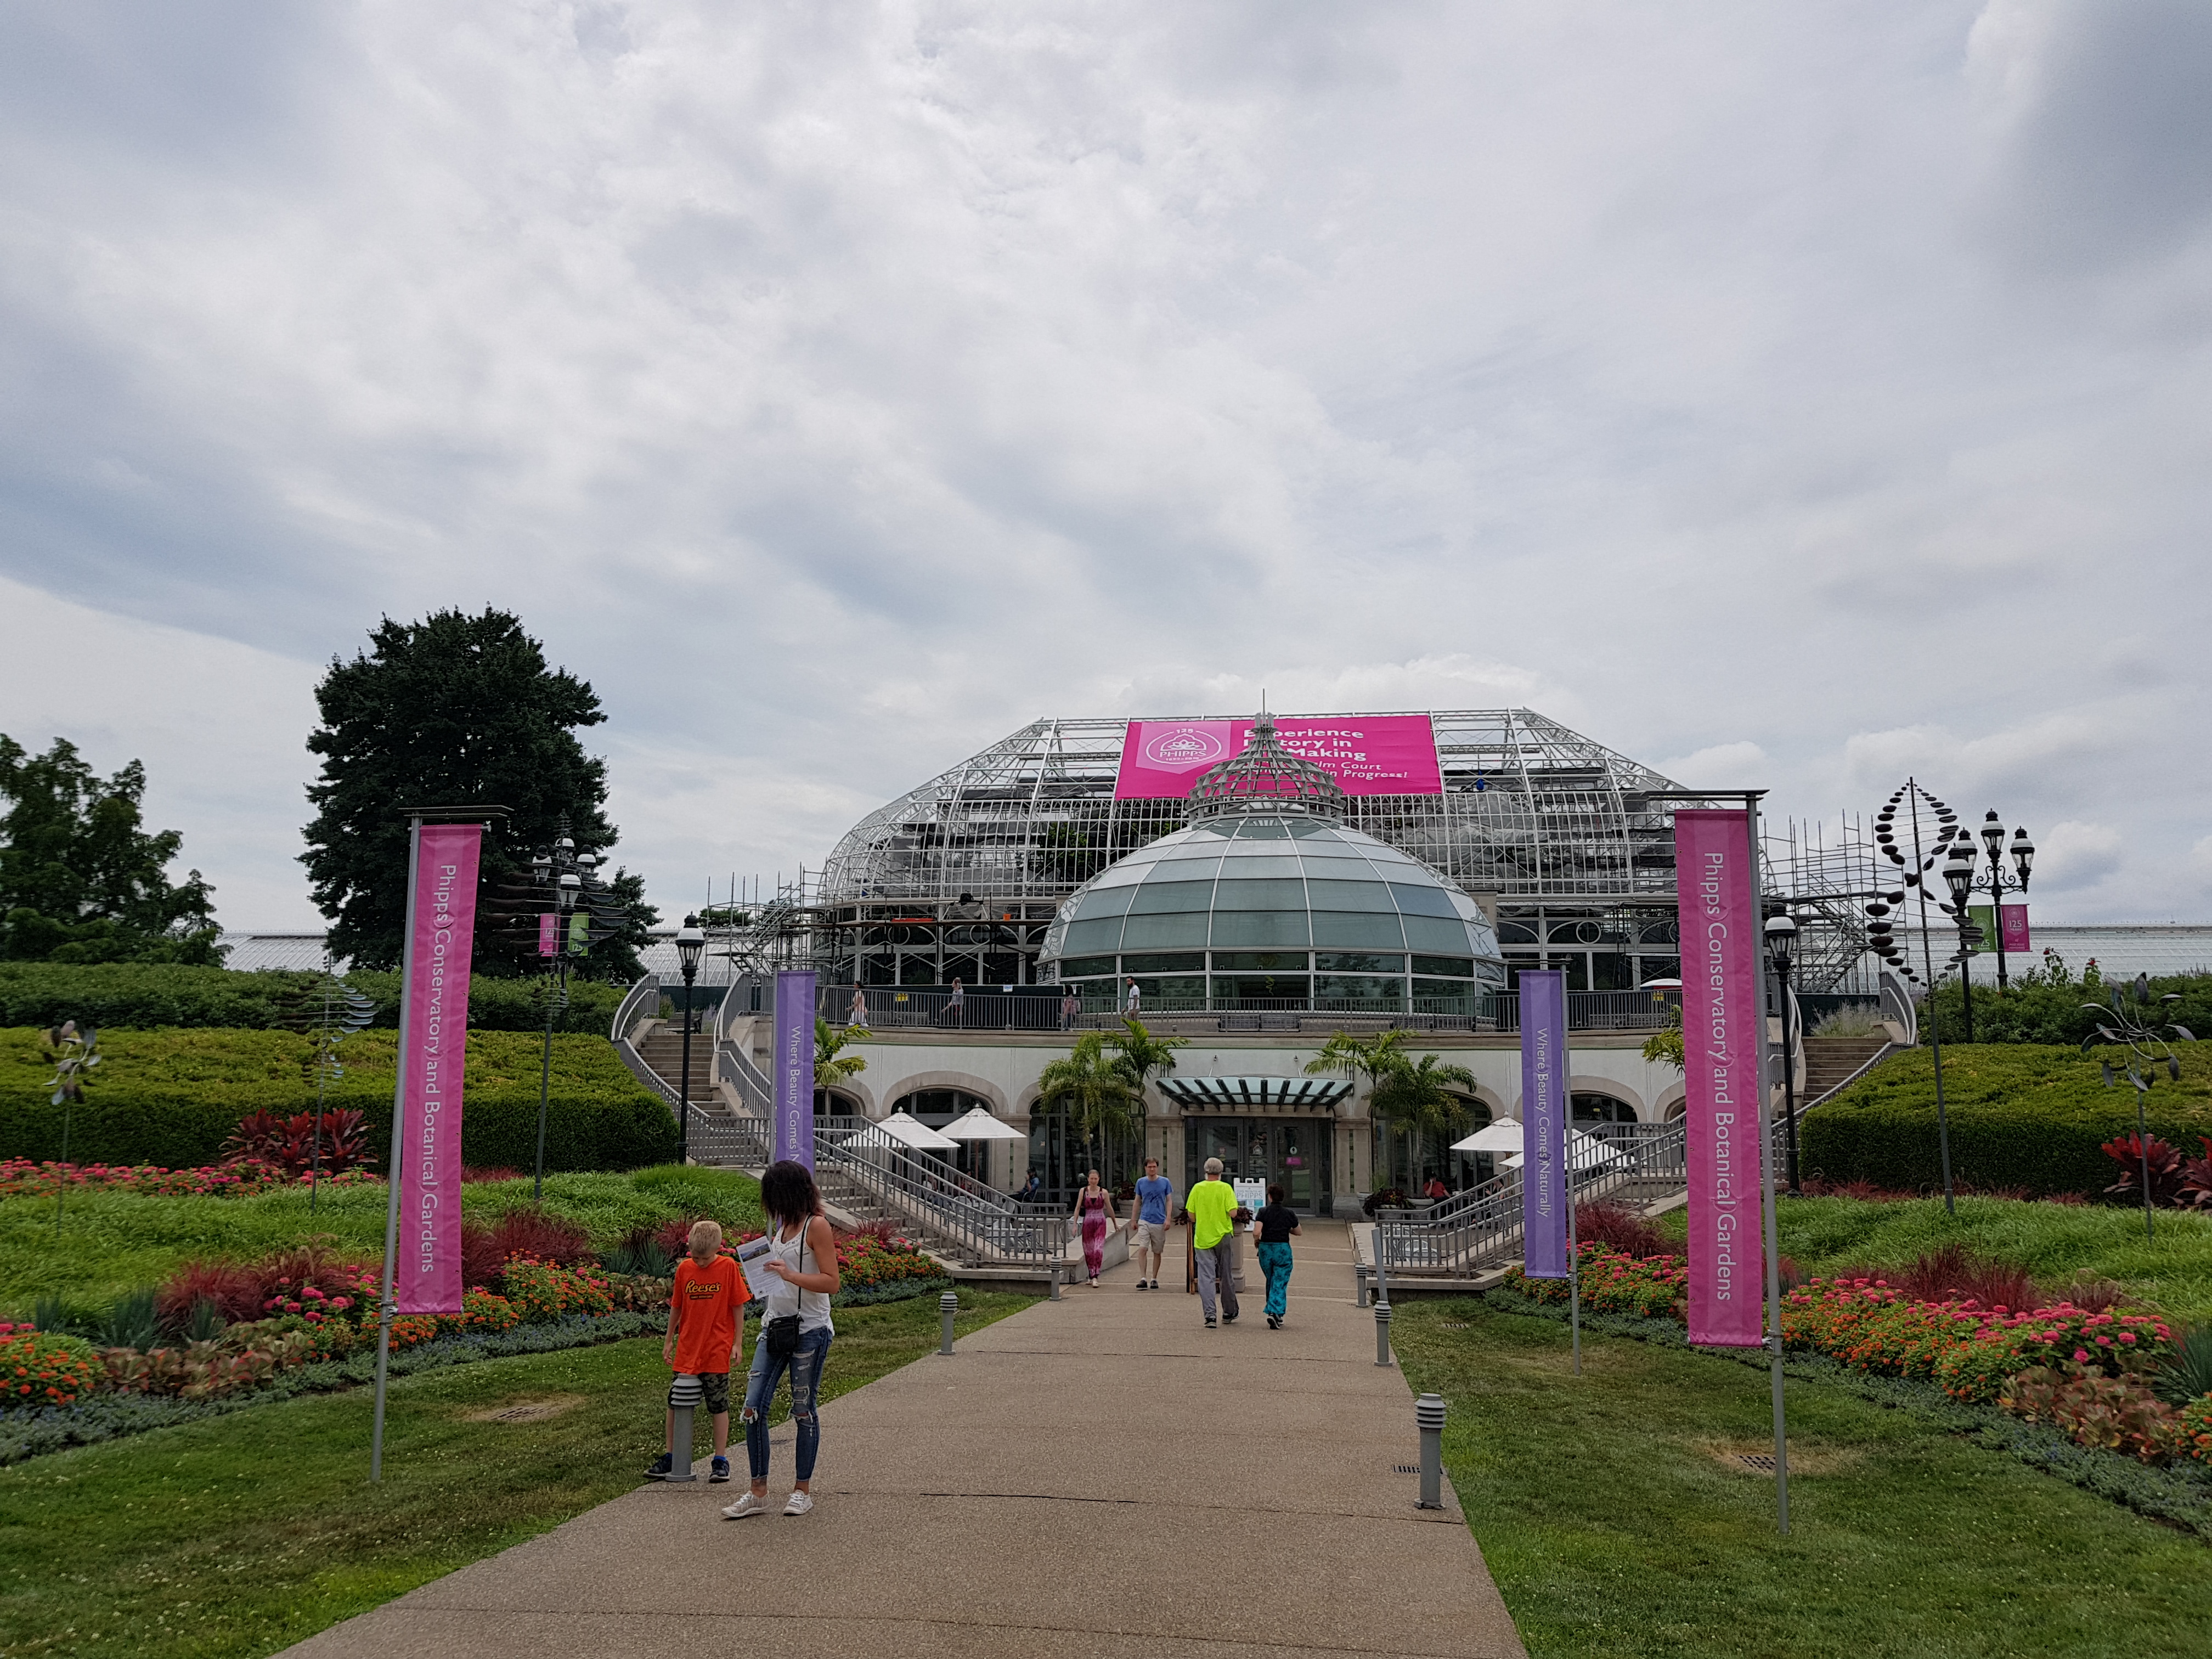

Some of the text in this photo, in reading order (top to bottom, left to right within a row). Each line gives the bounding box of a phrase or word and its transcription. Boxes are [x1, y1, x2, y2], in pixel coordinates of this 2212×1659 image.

[1244, 728, 1364, 738] Eperience
[1332, 738, 1352, 747] in
[1286, 748, 1367, 761] Making
[1341, 761, 1381, 770] Court
[1343, 769, 1408, 780] Progress!
[2009, 919, 2022, 928] 125
[790, 1025, 802, 1065] Where
[421, 865, 456, 1273] Phipps Conservatory and Botanical Gardens
[1700, 853, 1737, 1301] Phipps Conservatory and Botanical Gardens
[787, 1069, 800, 1106] Beauty
[789, 1110, 800, 1149] Comes
[1535, 1028, 1551, 1217] Where Beauty Comes Naturally
[685, 1279, 722, 1294] Reese's
